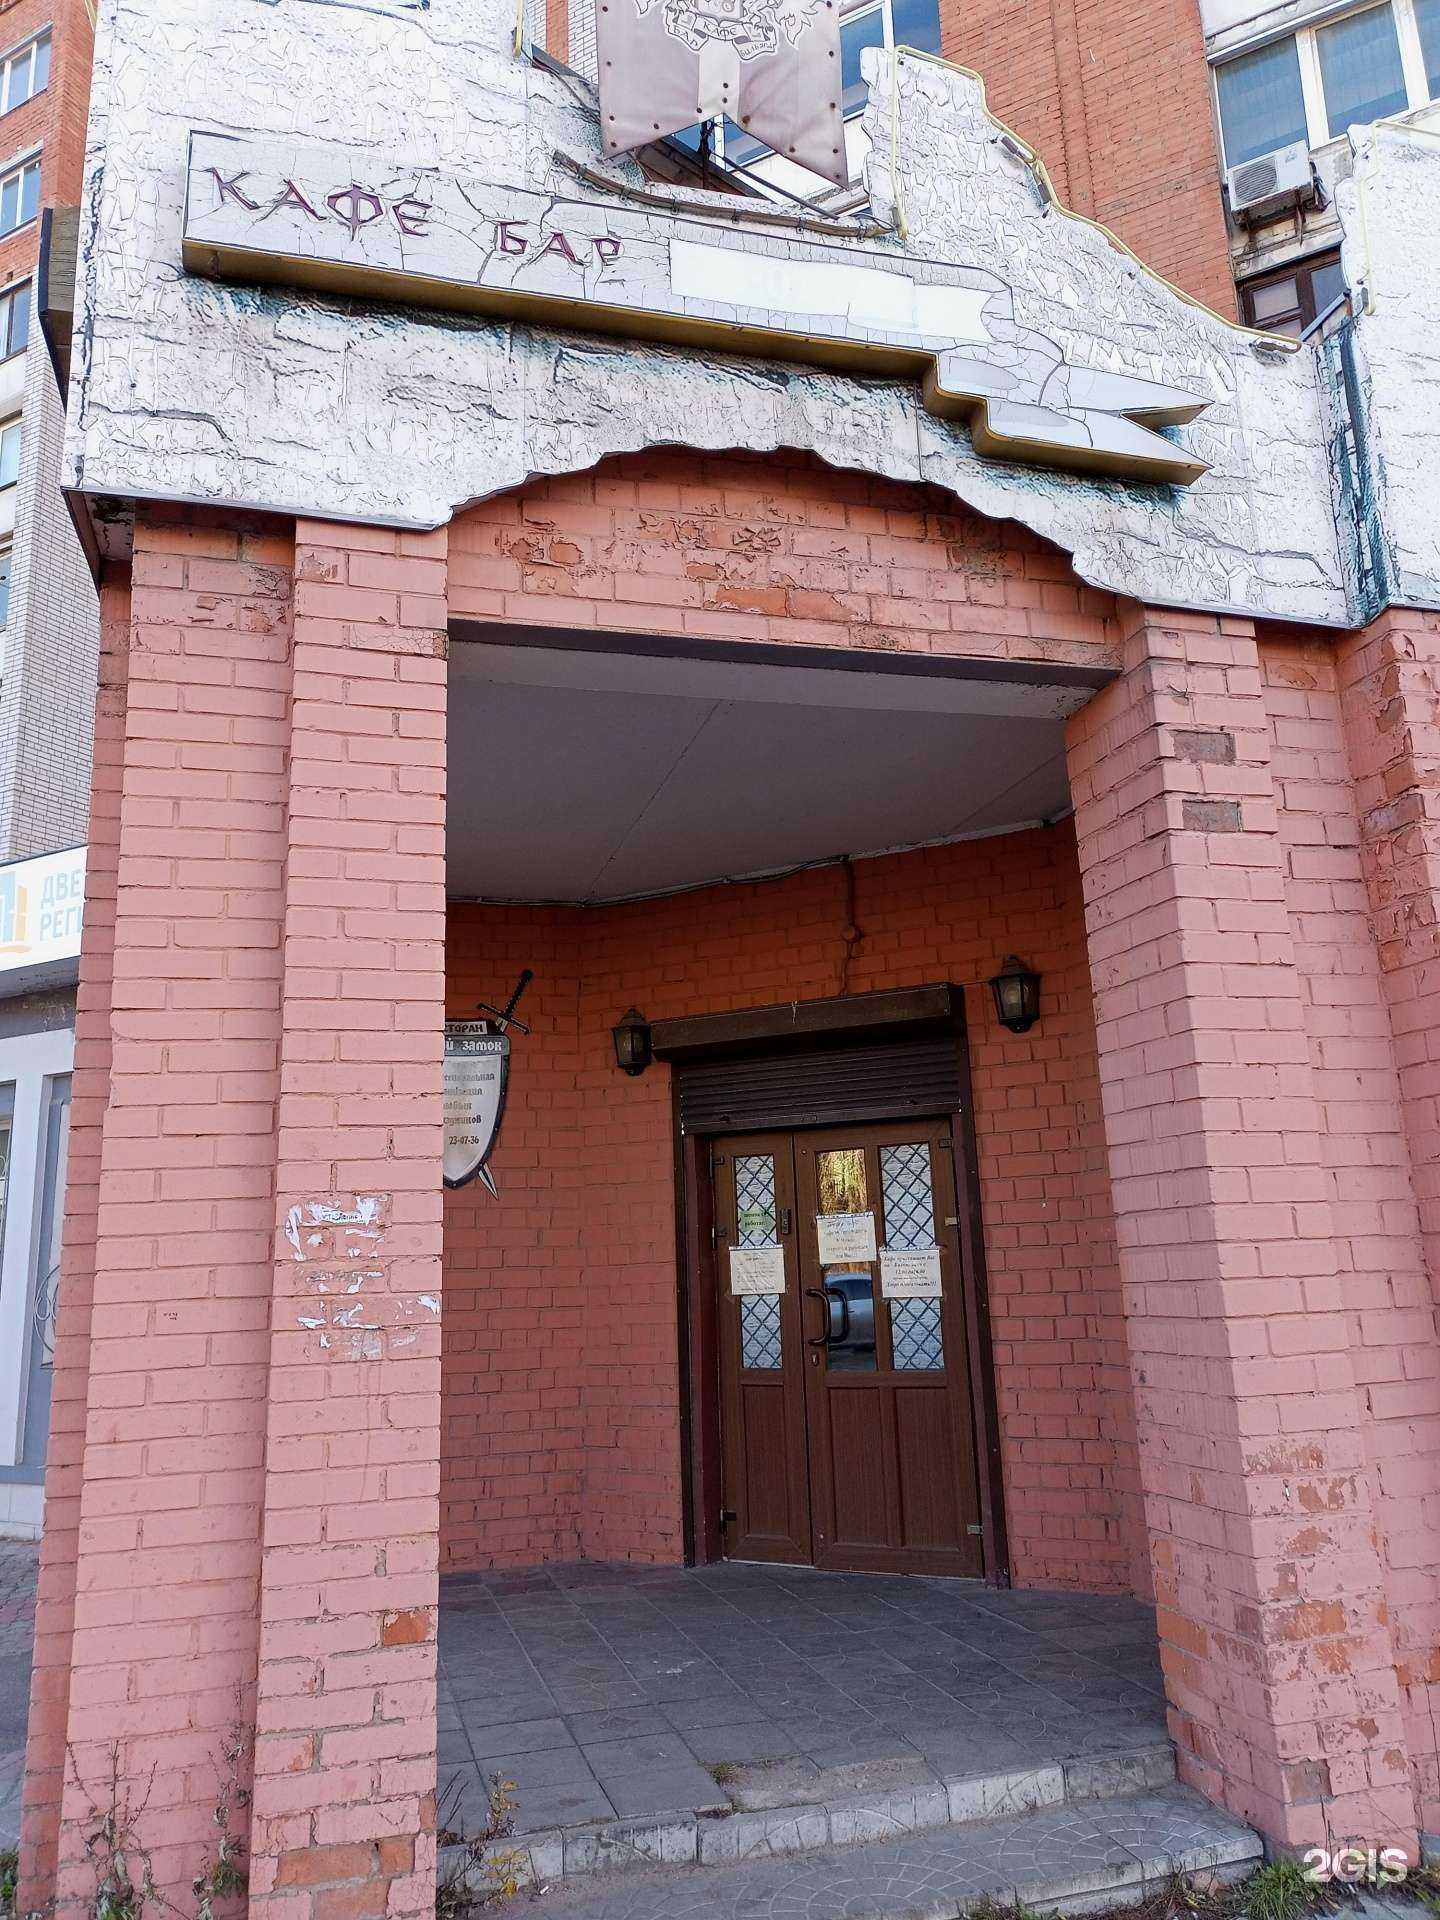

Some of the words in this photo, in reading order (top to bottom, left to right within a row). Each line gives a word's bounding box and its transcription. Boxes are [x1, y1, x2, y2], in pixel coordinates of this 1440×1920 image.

[704, 22, 737, 41] КАФЕ
[212, 167, 433, 242] КАФЕ
[496, 219, 624, 268] БАР
